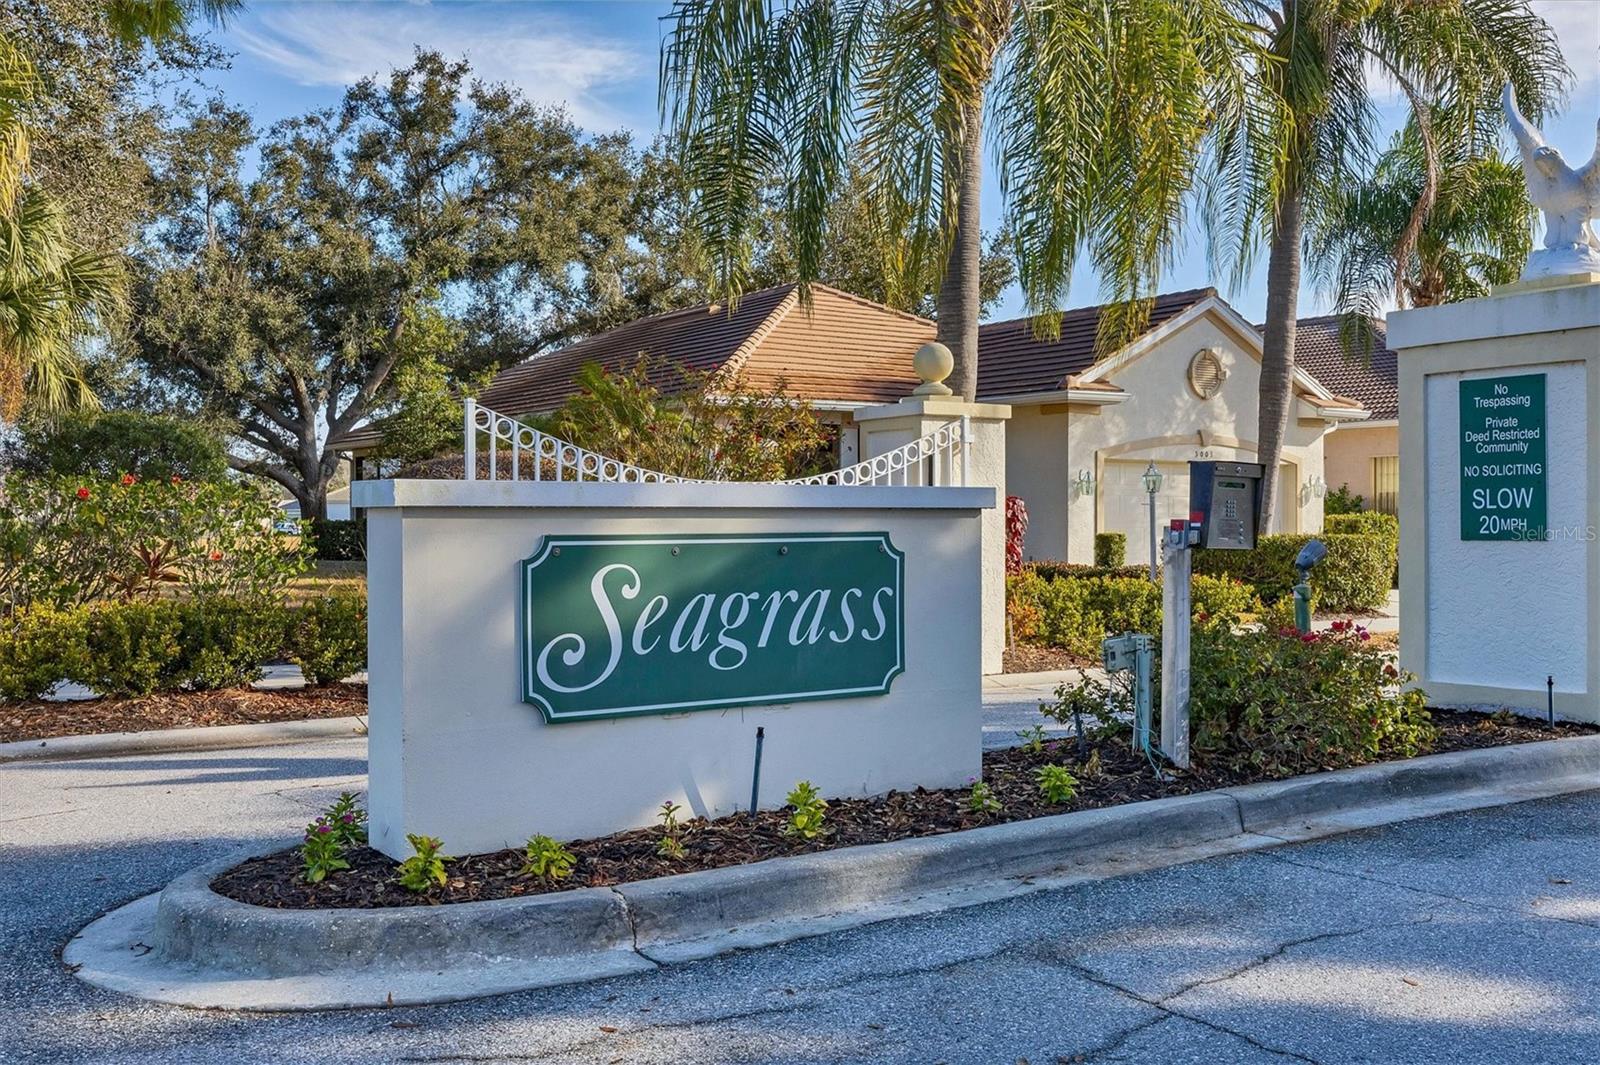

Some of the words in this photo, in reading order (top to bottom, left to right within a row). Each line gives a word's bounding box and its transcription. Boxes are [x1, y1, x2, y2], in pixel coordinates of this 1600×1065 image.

[1494, 384, 1508, 394] No
[1473, 395, 1531, 408] Trespassing
[1485, 416, 1518, 428] Private
[1465, 431, 1490, 442] Deed
[1492, 428, 1540, 441] Restricted
[1475, 442, 1529, 454] Community
[1464, 465, 1480, 477] NO
[1481, 463, 1542, 476] SOLICITING
[1472, 487, 1534, 510] SLOW
[536, 563, 894, 693] Seagrass
